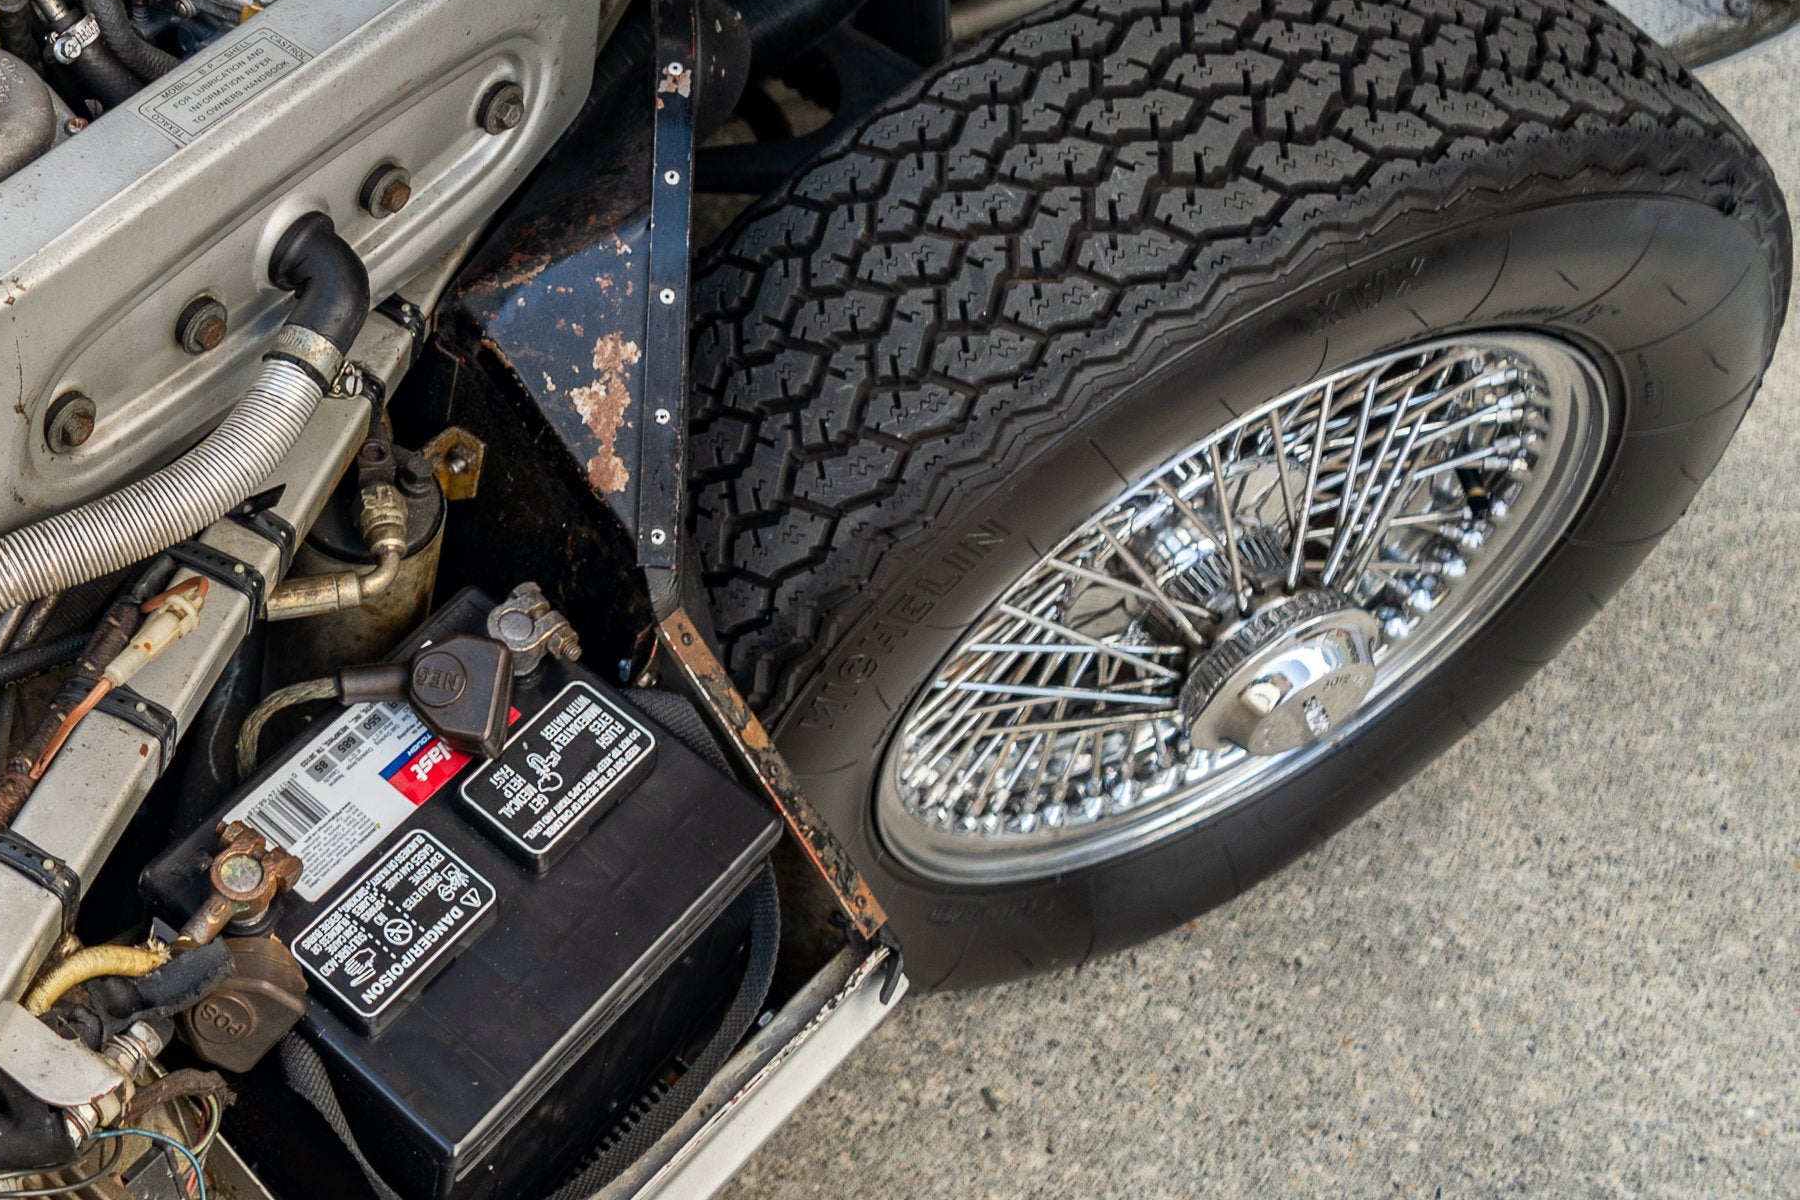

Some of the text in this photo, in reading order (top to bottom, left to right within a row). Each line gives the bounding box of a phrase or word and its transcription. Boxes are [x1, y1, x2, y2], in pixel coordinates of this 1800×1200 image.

[269, 33, 306, 60] CASTROL
[161, 78, 189, 100] MOBIL
[223, 38, 251, 59] SHELL
[172, 46, 265, 110] FOR LUBRICATION AND
[188, 55, 272, 114] INFORMATION REFER
[191, 58, 289, 126] TO OWNERS HANDBOOK
[151, 113, 184, 137] TEXACO
[796, 515, 1012, 730] MICHELIN
[414, 665, 460, 692] NEG
[361, 712, 382, 732] 550
[538, 692, 591, 741] WITH WATER
[548, 701, 603, 752] IMMEDIATELY
[587, 710, 614, 736] EYES
[335, 734, 357, 754] 685
[405, 732, 432, 756] TOUGH
[594, 719, 625, 750] FLUSH
[616, 735, 633, 751] NOT
[627, 727, 641, 740] DO
[408, 740, 452, 783] last
[593, 754, 613, 773] KEEP
[611, 756, 627, 771] OUT
[622, 743, 641, 761] KEEP
[313, 758, 329, 774] 85
[487, 763, 514, 789] FAST
[580, 767, 599, 785] VENT
[603, 766, 616, 779] OF
[499, 772, 526, 799] HELP
[565, 780, 586, 800] CAPS
[593, 774, 609, 788] THE
[497, 781, 538, 821] MEDICAL
[526, 791, 550, 814] GET
[551, 794, 571, 813] TIGHT
[568, 800, 582, 813] OF
[576, 783, 599, 806] REACH
[539, 808, 557, 825] AND
[368, 833, 424, 887] BLINDNESS OR INJURY
[380, 842, 434, 892] GASES CAN CAUSE
[407, 849, 445, 887] EXPLOSIVE
[339, 885, 368, 912] SMOKING
[349, 891, 376, 917] FLAMES
[400, 871, 443, 911] SHIELD EYES
[358, 898, 384, 923] SPARKS
[371, 910, 388, 927] NO
[299, 909, 343, 950] SEVERE BURNS
[309, 915, 350, 955] BLINDNESS OR
[323, 922, 358, 955] CAN CAUSE
[317, 929, 367, 977] SULFURIC ACID
[359, 904, 464, 1005] DANGER/POISON
[199, 1001, 246, 1039] POS
